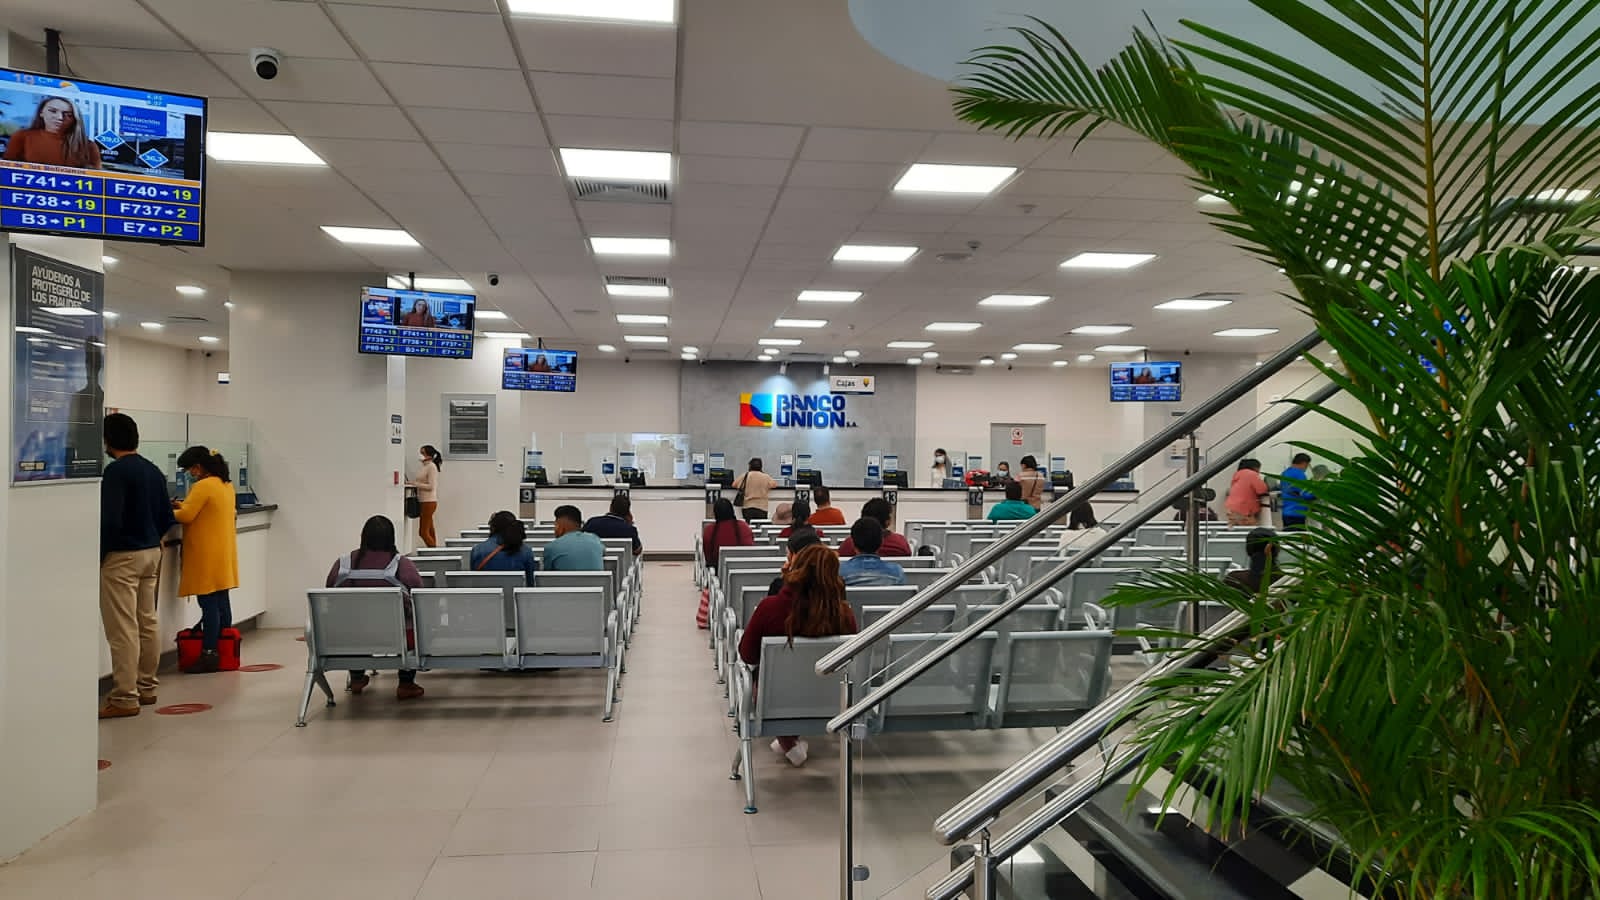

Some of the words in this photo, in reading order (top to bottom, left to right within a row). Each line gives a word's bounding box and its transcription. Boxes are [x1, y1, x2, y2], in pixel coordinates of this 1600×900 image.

[11, 172, 56, 187] F741
[75, 179, 92, 191] 11
[114, 183, 157, 197] F740
[172, 189, 192, 200] 19
[11, 192, 58, 207] F738
[75, 199, 96, 210] 19
[120, 202, 162, 216] F737
[176, 208, 187, 218] 2
[21, 213, 47, 225] B3
[63, 217, 86, 228] P1
[123, 221, 146, 233] E7
[161, 224, 183, 236] P2
[32, 278, 80, 300] PROTEGERLO
[80, 290, 91, 302] DE
[75, 278, 81, 288] A
[32, 290, 48, 304] LOS
[836, 379, 856, 388] Cajas
[777, 395, 846, 412] BANCO
[777, 411, 846, 428] UNION
[522, 489, 533, 502] 9
[885, 491, 897, 505] 13
